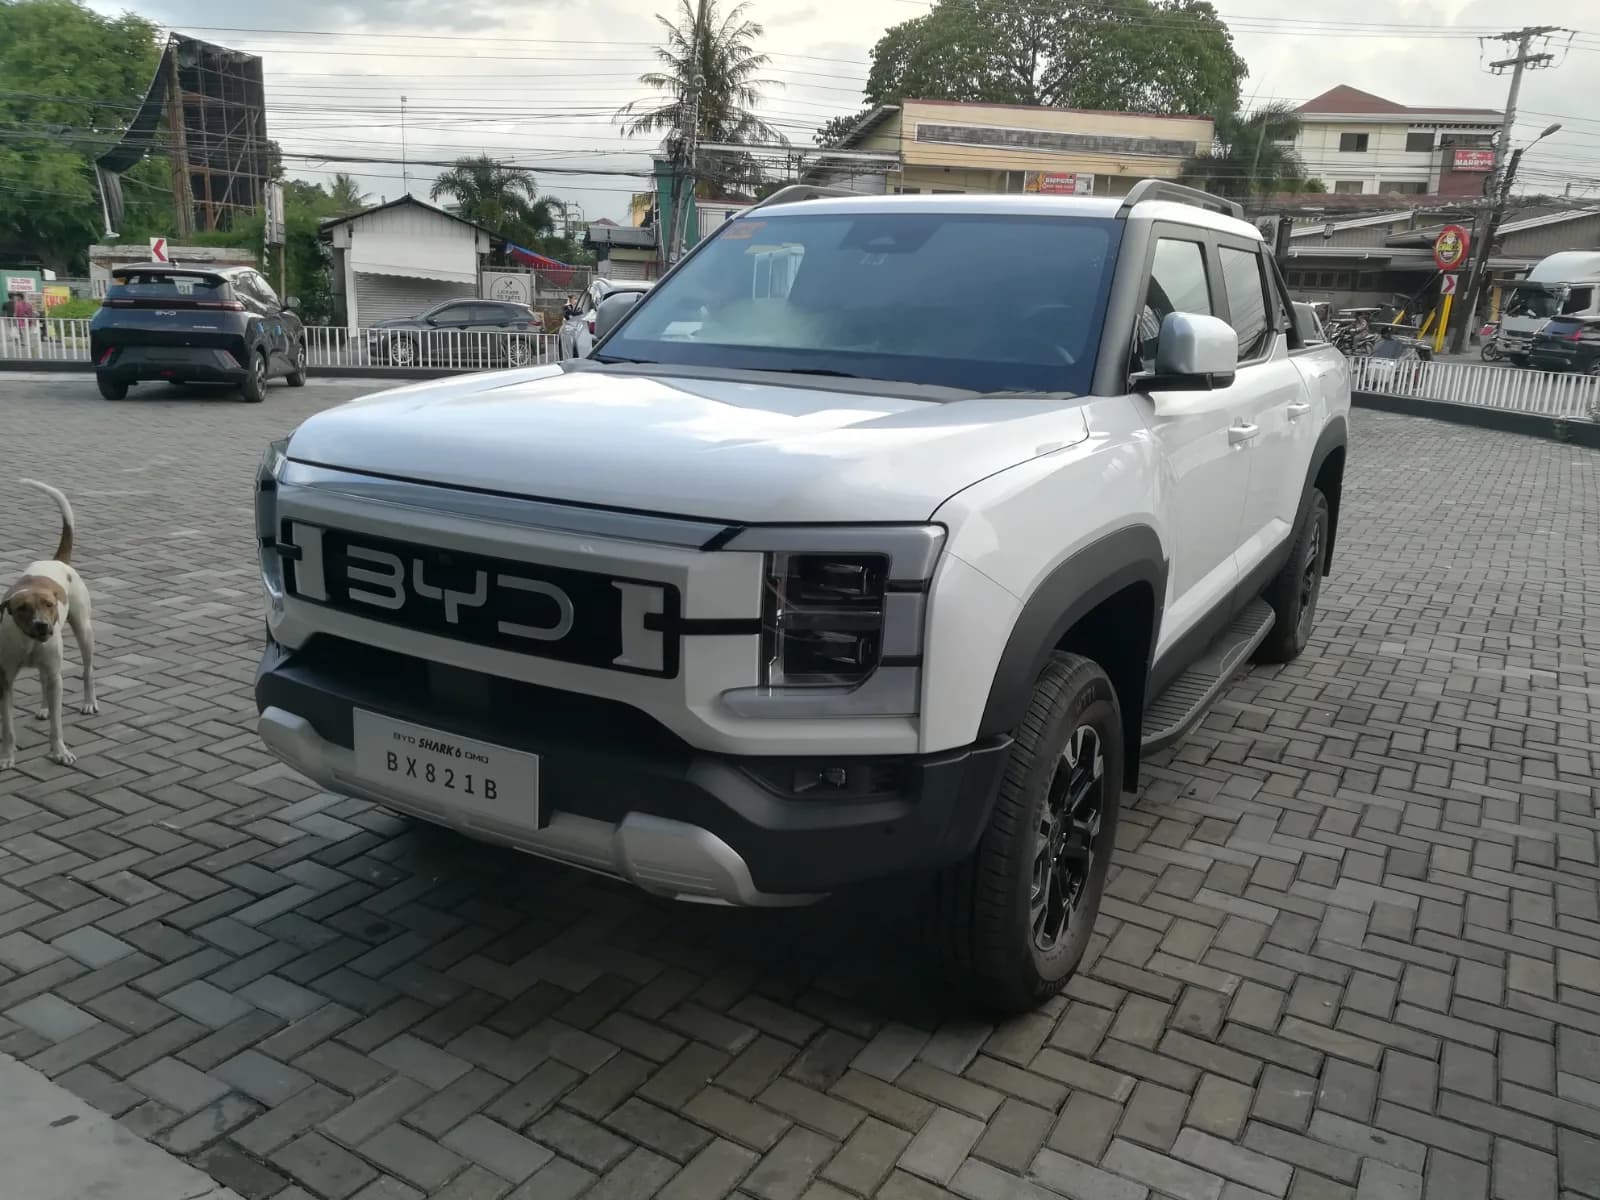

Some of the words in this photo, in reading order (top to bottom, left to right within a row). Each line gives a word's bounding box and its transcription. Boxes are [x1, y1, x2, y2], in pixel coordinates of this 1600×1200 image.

[346, 544, 575, 641] BYD
[392, 731, 416, 744] BYD
[418, 738, 454, 756] SHARK
[386, 751, 498, 800] BX821B
